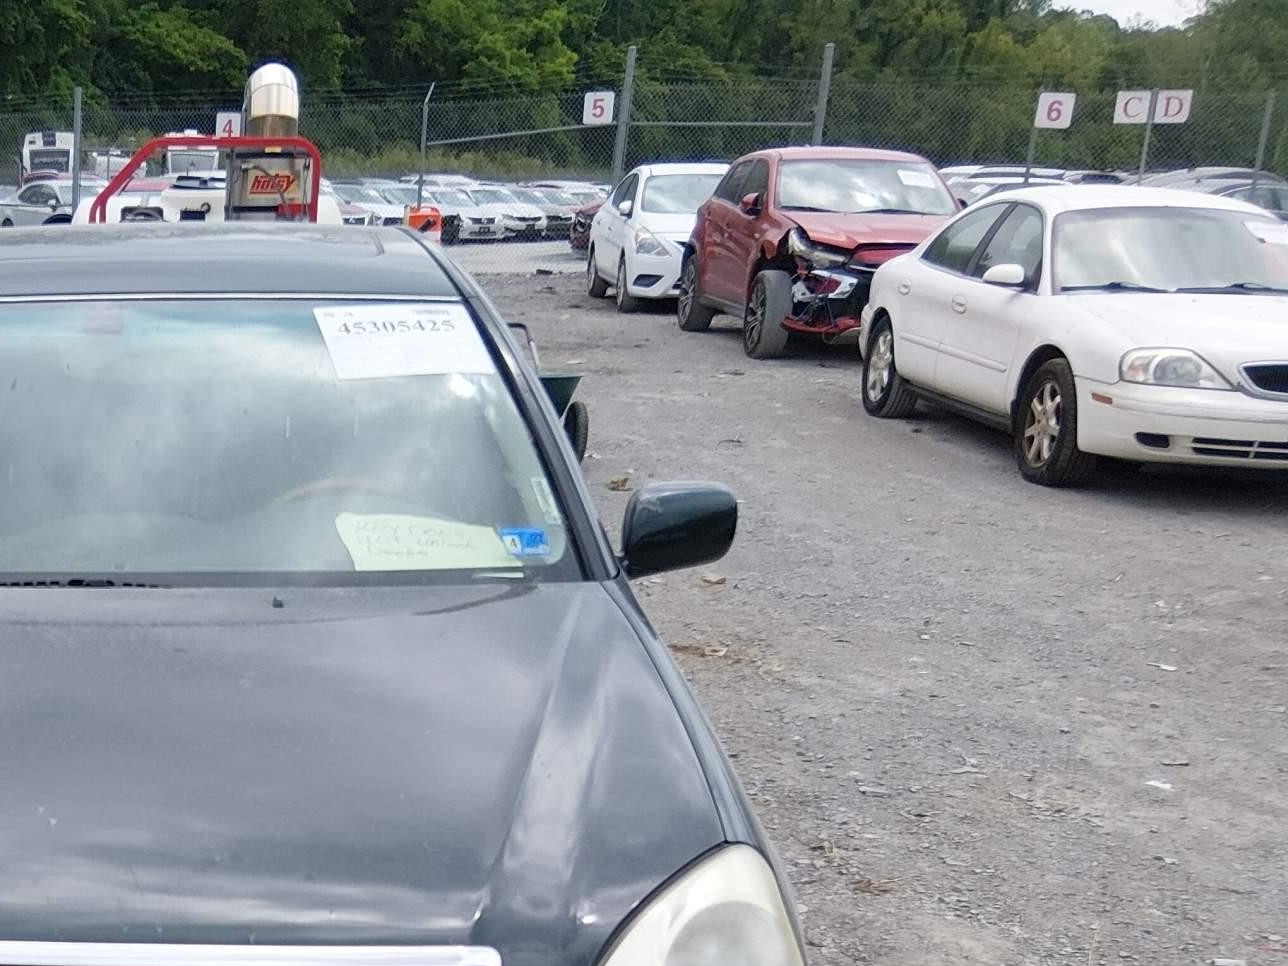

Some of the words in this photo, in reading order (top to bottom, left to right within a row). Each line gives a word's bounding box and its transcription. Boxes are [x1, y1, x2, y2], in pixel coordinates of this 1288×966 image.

[592, 98, 604, 119] 5
[1047, 100, 1063, 122] 6
[1123, 96, 1143, 118] C
[1162, 96, 1183, 118] D
[222, 119, 233, 137] 4
[338, 319, 456, 335] 45305425
